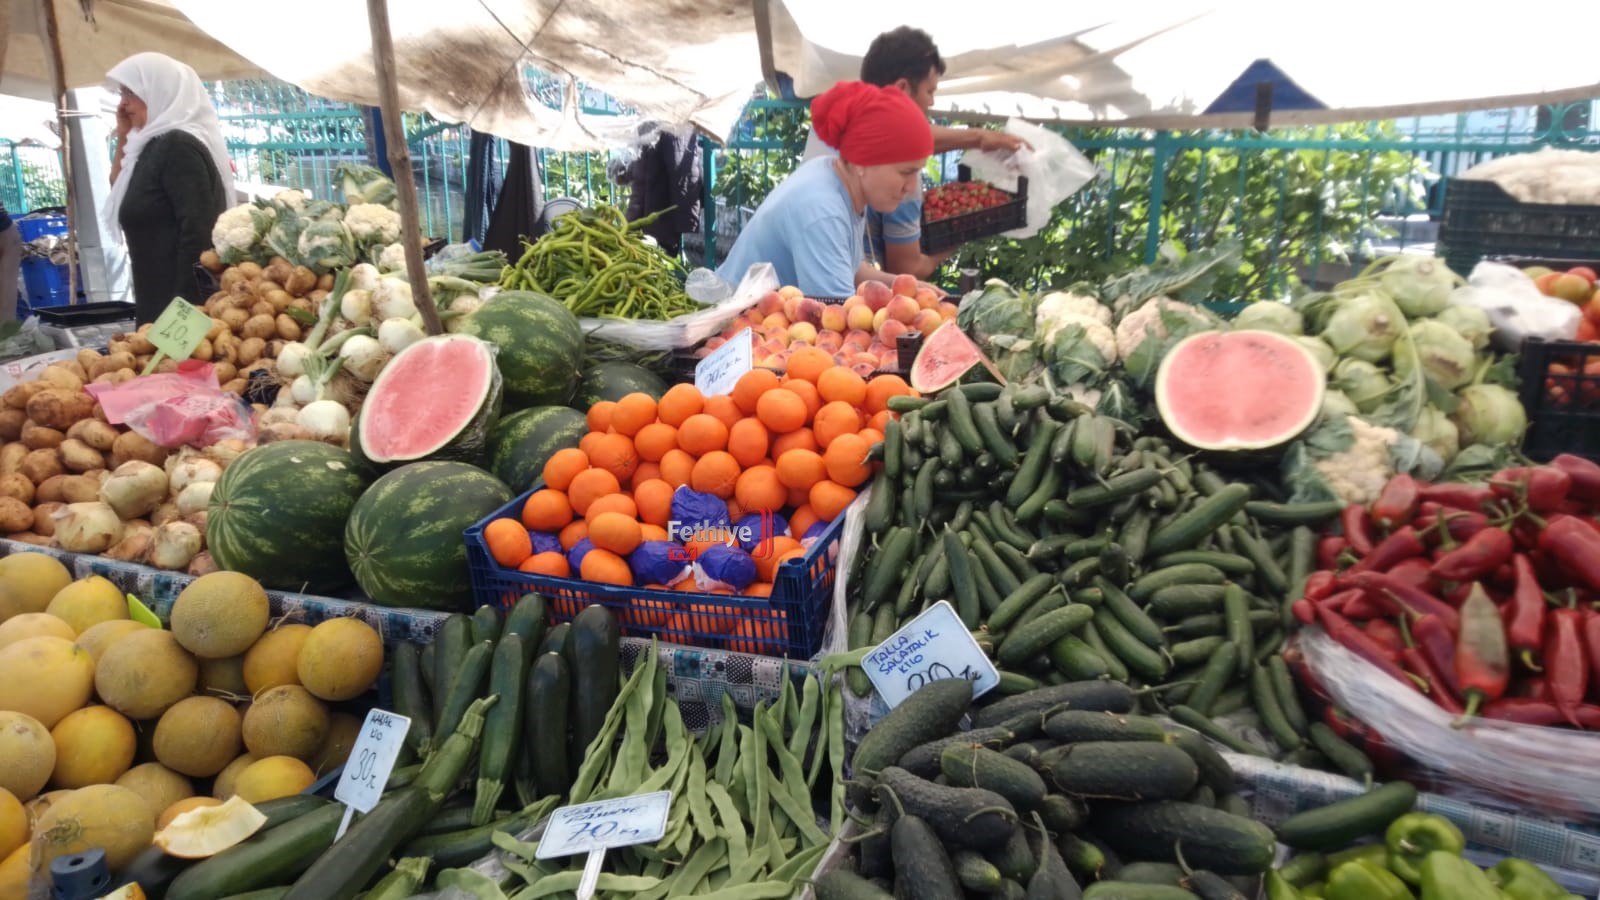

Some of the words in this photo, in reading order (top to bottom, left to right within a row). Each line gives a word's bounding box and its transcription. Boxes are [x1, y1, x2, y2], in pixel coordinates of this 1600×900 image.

[868, 636, 909, 665] TALLA
[879, 629, 940, 675] SALATALIK
[350, 748, 377, 781] 30
[567, 821, 619, 842] 70
